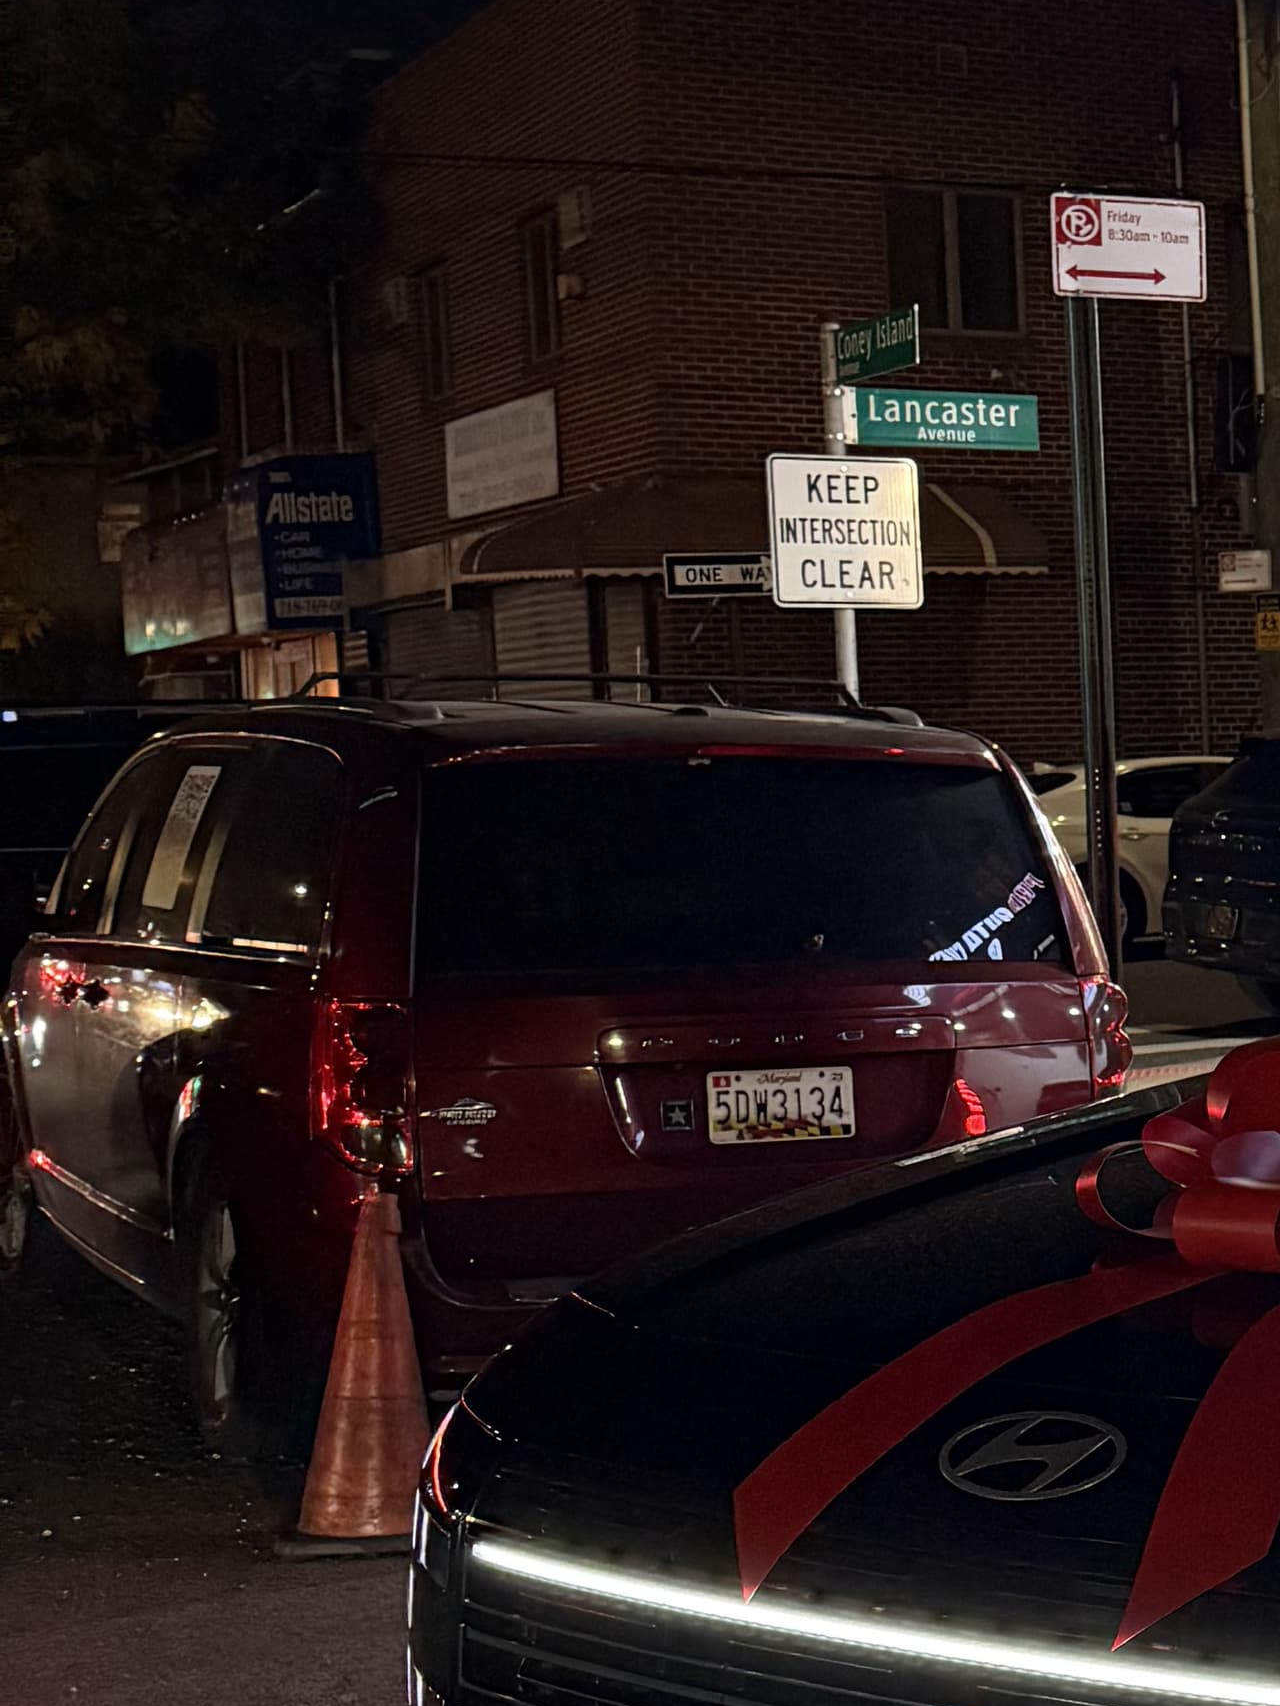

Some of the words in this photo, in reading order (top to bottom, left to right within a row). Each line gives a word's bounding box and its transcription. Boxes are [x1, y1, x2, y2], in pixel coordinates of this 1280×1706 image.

[1107, 209, 1142, 226] Friday
[1108, 229, 1150, 243] 8:30am
[1161, 231, 1190, 245] 10am
[836, 328, 873, 362] Coney
[876, 310, 914, 349] Island
[868, 394, 1021, 428] Lancaster
[917, 425, 977, 443] Avenue
[806, 473, 880, 505] KEEP
[265, 491, 354, 525] Allstate
[779, 517, 912, 547] INTERSECTION
[685, 567, 723, 583] ONE
[800, 559, 896, 590] CLEAR
[714, 1085, 844, 1127] 5DW3134
